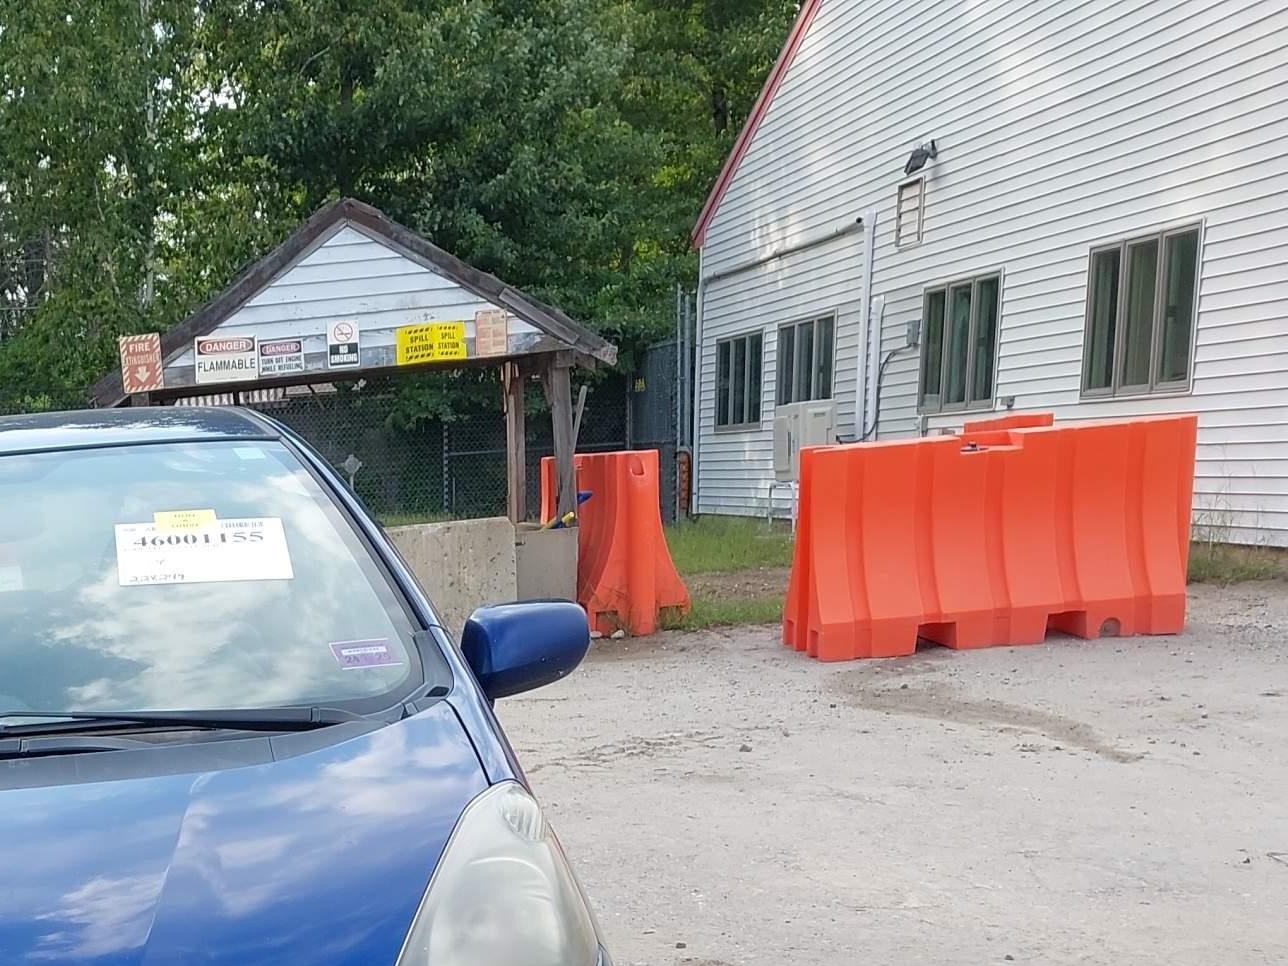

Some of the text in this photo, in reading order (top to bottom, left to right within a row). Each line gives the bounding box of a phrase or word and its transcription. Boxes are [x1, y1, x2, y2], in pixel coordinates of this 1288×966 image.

[409, 335, 430, 344] SPILL
[440, 332, 456, 340] SPILL
[129, 341, 151, 353] FIRE
[206, 341, 247, 352] DANGER
[339, 345, 348, 354] NO
[405, 343, 435, 354] STATION
[438, 341, 460, 349] STATION
[330, 353, 358, 364] SMOKING
[197, 358, 256, 373] FLAMMABLE
[133, 531, 264, 547] 46001155
